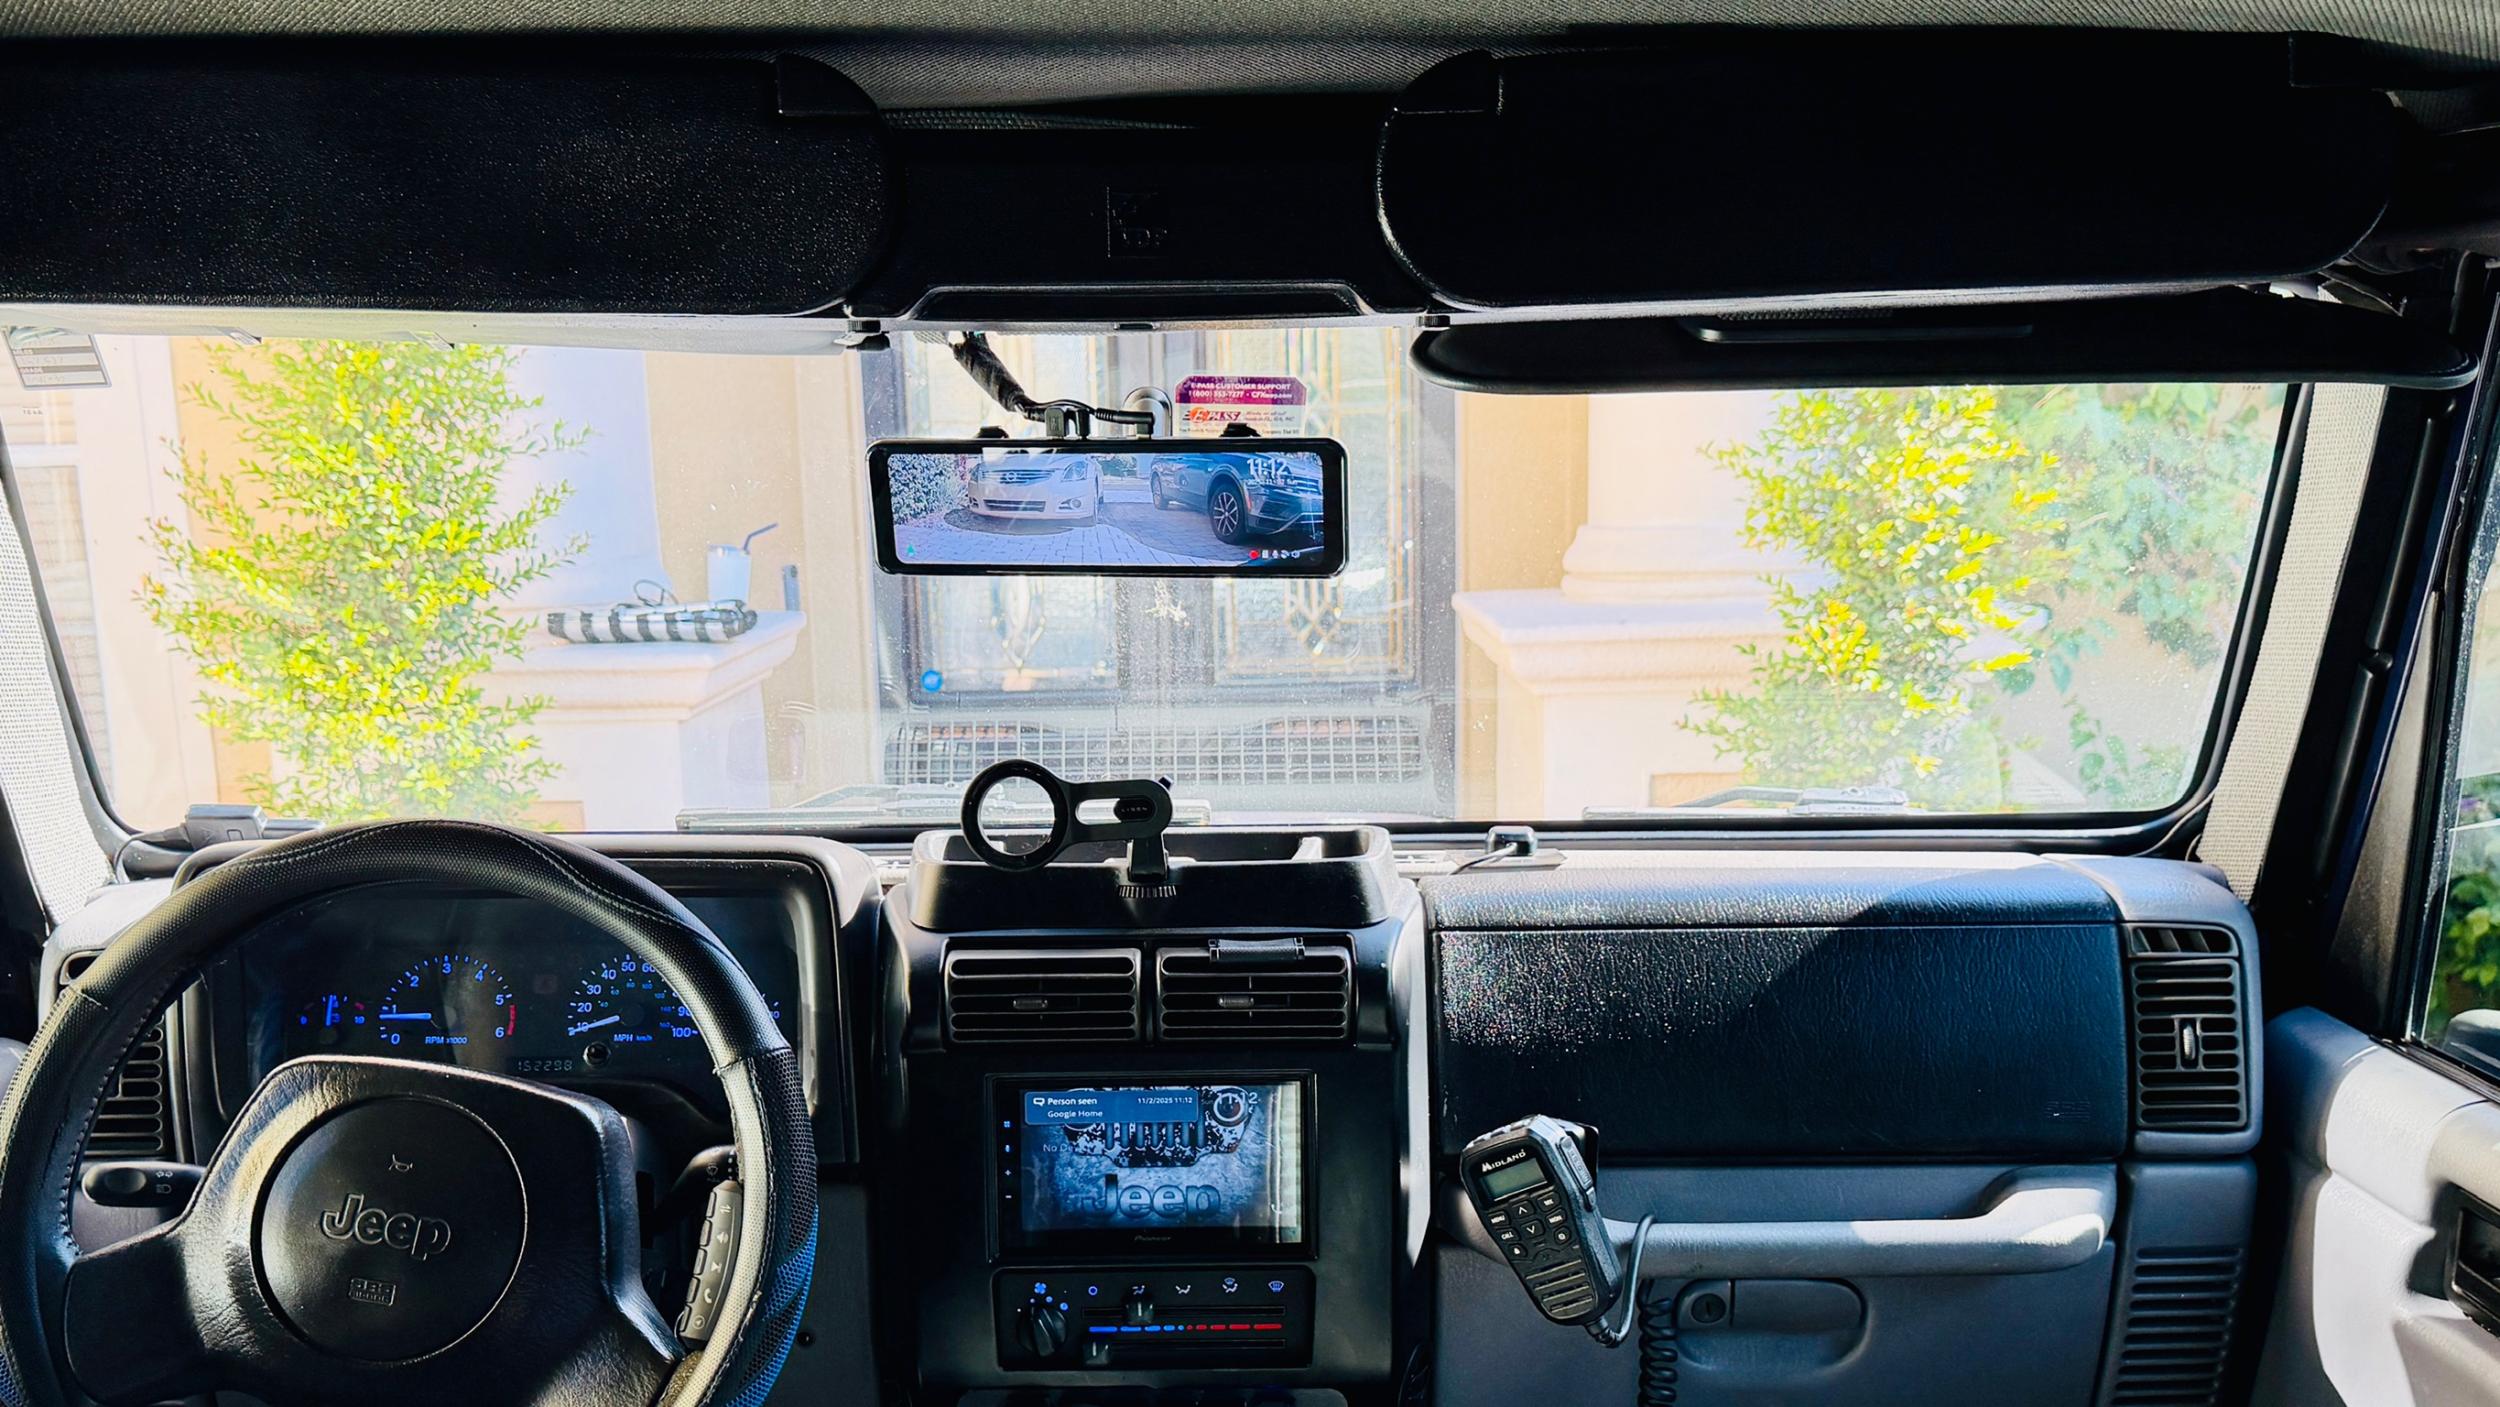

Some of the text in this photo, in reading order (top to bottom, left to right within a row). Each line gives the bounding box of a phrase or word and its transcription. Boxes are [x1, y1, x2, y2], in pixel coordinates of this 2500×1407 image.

[1215, 382, 1256, 391] CUSTOMER
[1256, 383, 1291, 391] SUPPORT
[1246, 458, 1288, 479] 11:12
[442, 963, 452, 974] 3
[621, 962, 636, 972] 50
[474, 971, 484, 982] 4
[601, 969, 617, 980] 40
[410, 976, 419, 987] 2
[586, 984, 602, 995] 30
[495, 994, 504, 1005] 5
[391, 1004, 397, 1013] 1
[577, 1002, 592, 1013] 20
[495, 1027, 504, 1038] 6
[613, 1033, 633, 1042] MPH
[672, 1027, 692, 1038] 100
[390, 1033, 400, 1044] 0
[425, 1036, 444, 1045] RPM
[518, 1060, 572, 1071] 152298
[1047, 1097, 1097, 1106] Person seen
[1047, 1109, 1103, 1119] Google Home
[1481, 1150, 1527, 1172] MIDLAND
[1083, 1173, 1222, 1220] Jeep
[320, 1192, 453, 1262] Jeep
